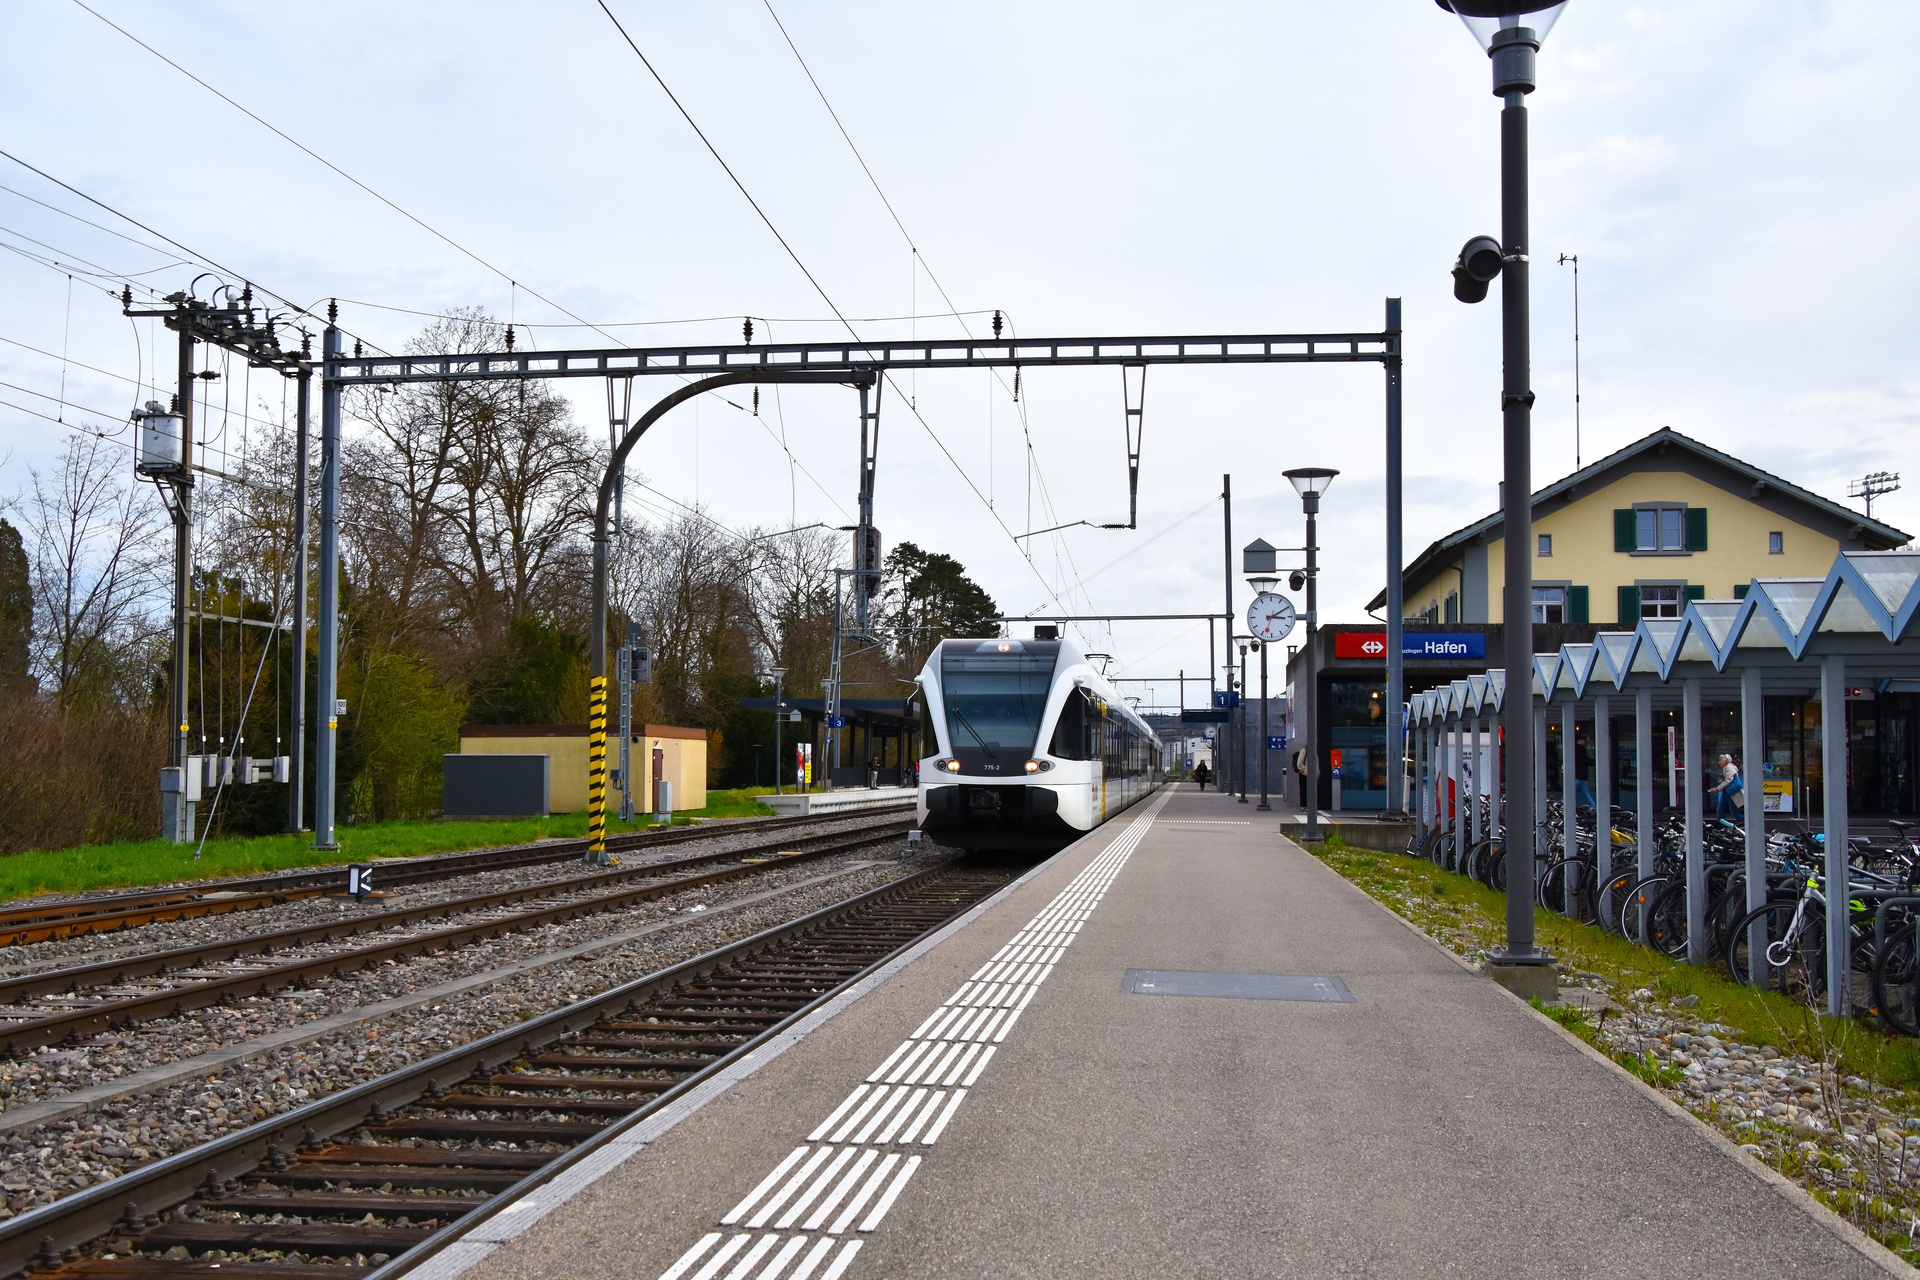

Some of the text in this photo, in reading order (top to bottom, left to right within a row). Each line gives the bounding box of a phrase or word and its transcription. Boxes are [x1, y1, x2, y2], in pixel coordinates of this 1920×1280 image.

[1425, 641, 1467, 654] Hafen
[1845, 688, 1861, 697] ec
[1220, 696, 1225, 705] 1
